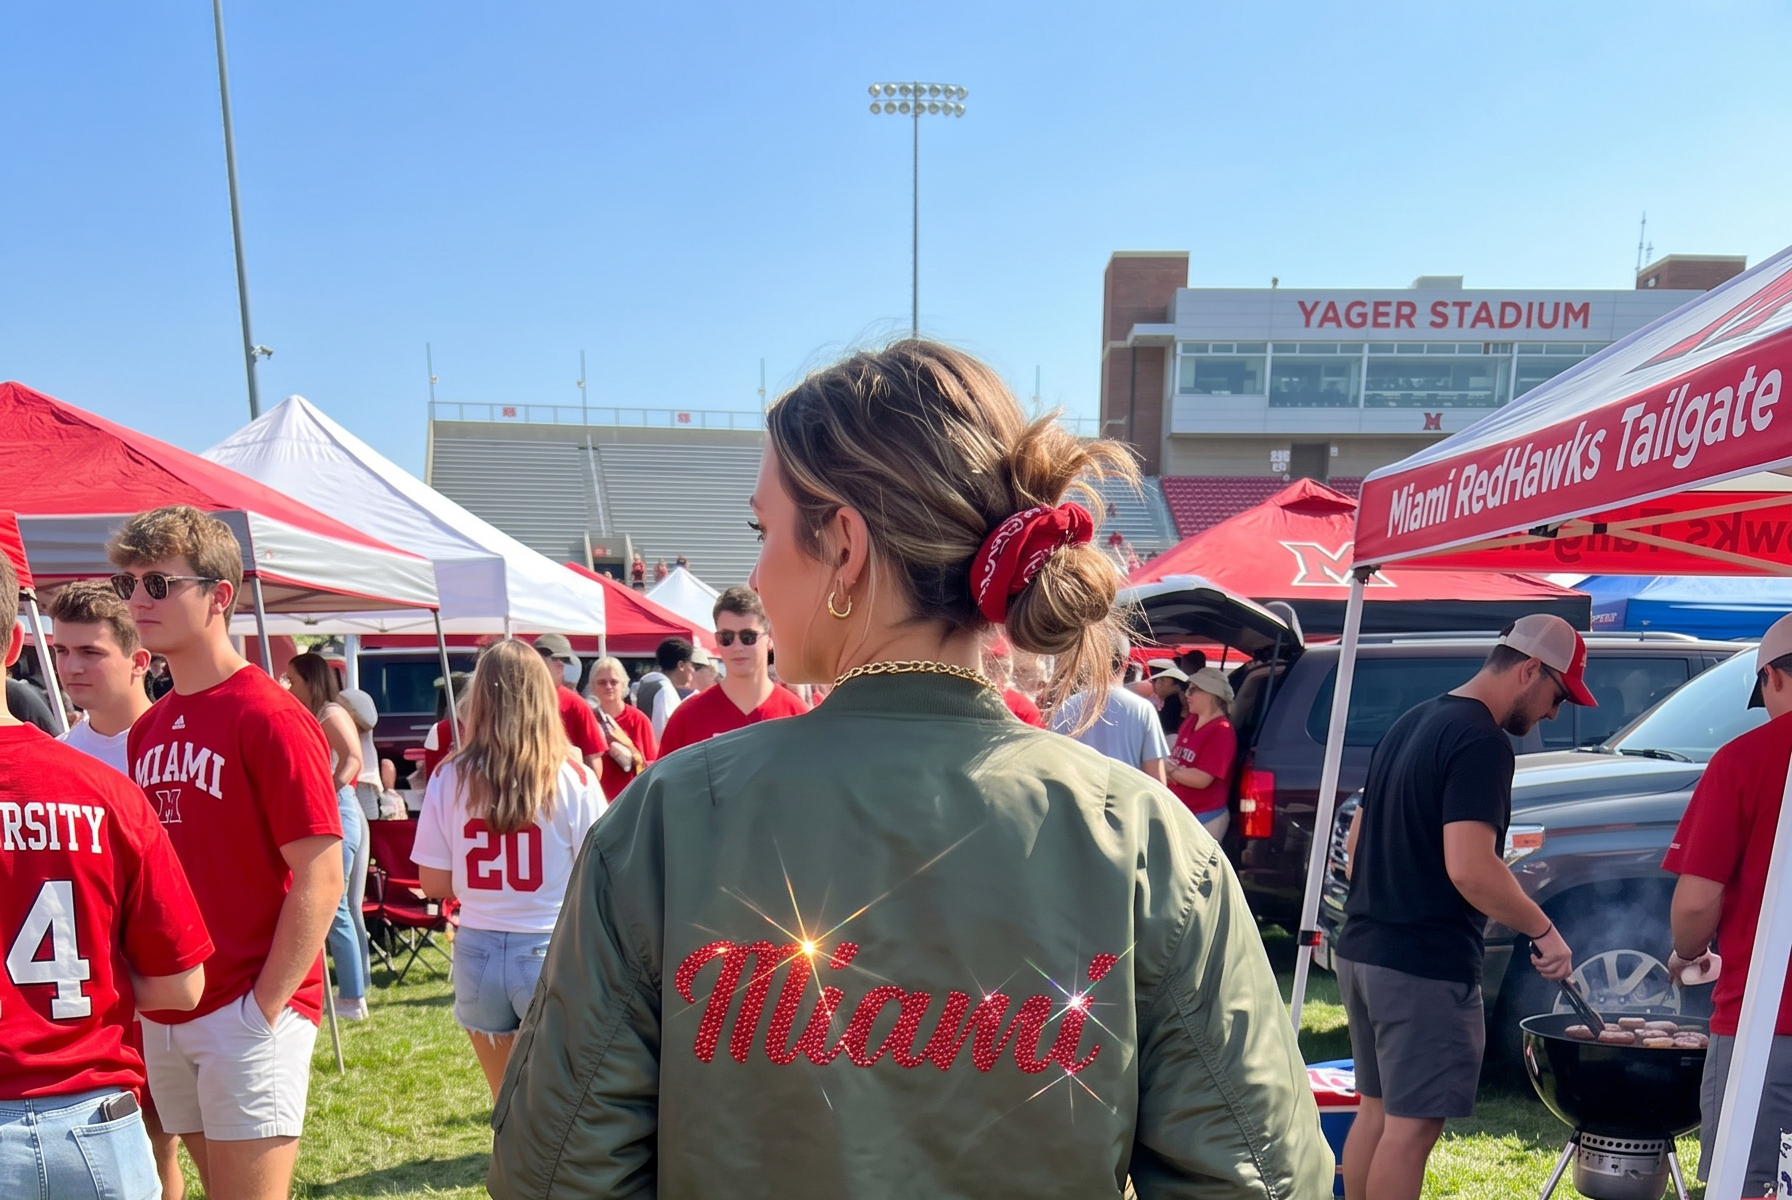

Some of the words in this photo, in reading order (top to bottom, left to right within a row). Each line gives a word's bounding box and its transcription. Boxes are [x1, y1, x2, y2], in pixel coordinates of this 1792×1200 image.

[1297, 300, 1418, 329] YAGER
[1428, 300, 1591, 330] STADIUM
[1386, 468, 1457, 538] Miami
[1454, 420, 1607, 518] RedHawks
[1615, 364, 1783, 470] Tailgate
[135, 741, 226, 800] MIAMI
[0, 801, 105, 854] RSITY
[463, 818, 544, 893] 20
[5, 880, 92, 1020] 4
[674, 939, 1119, 1075] Miami
